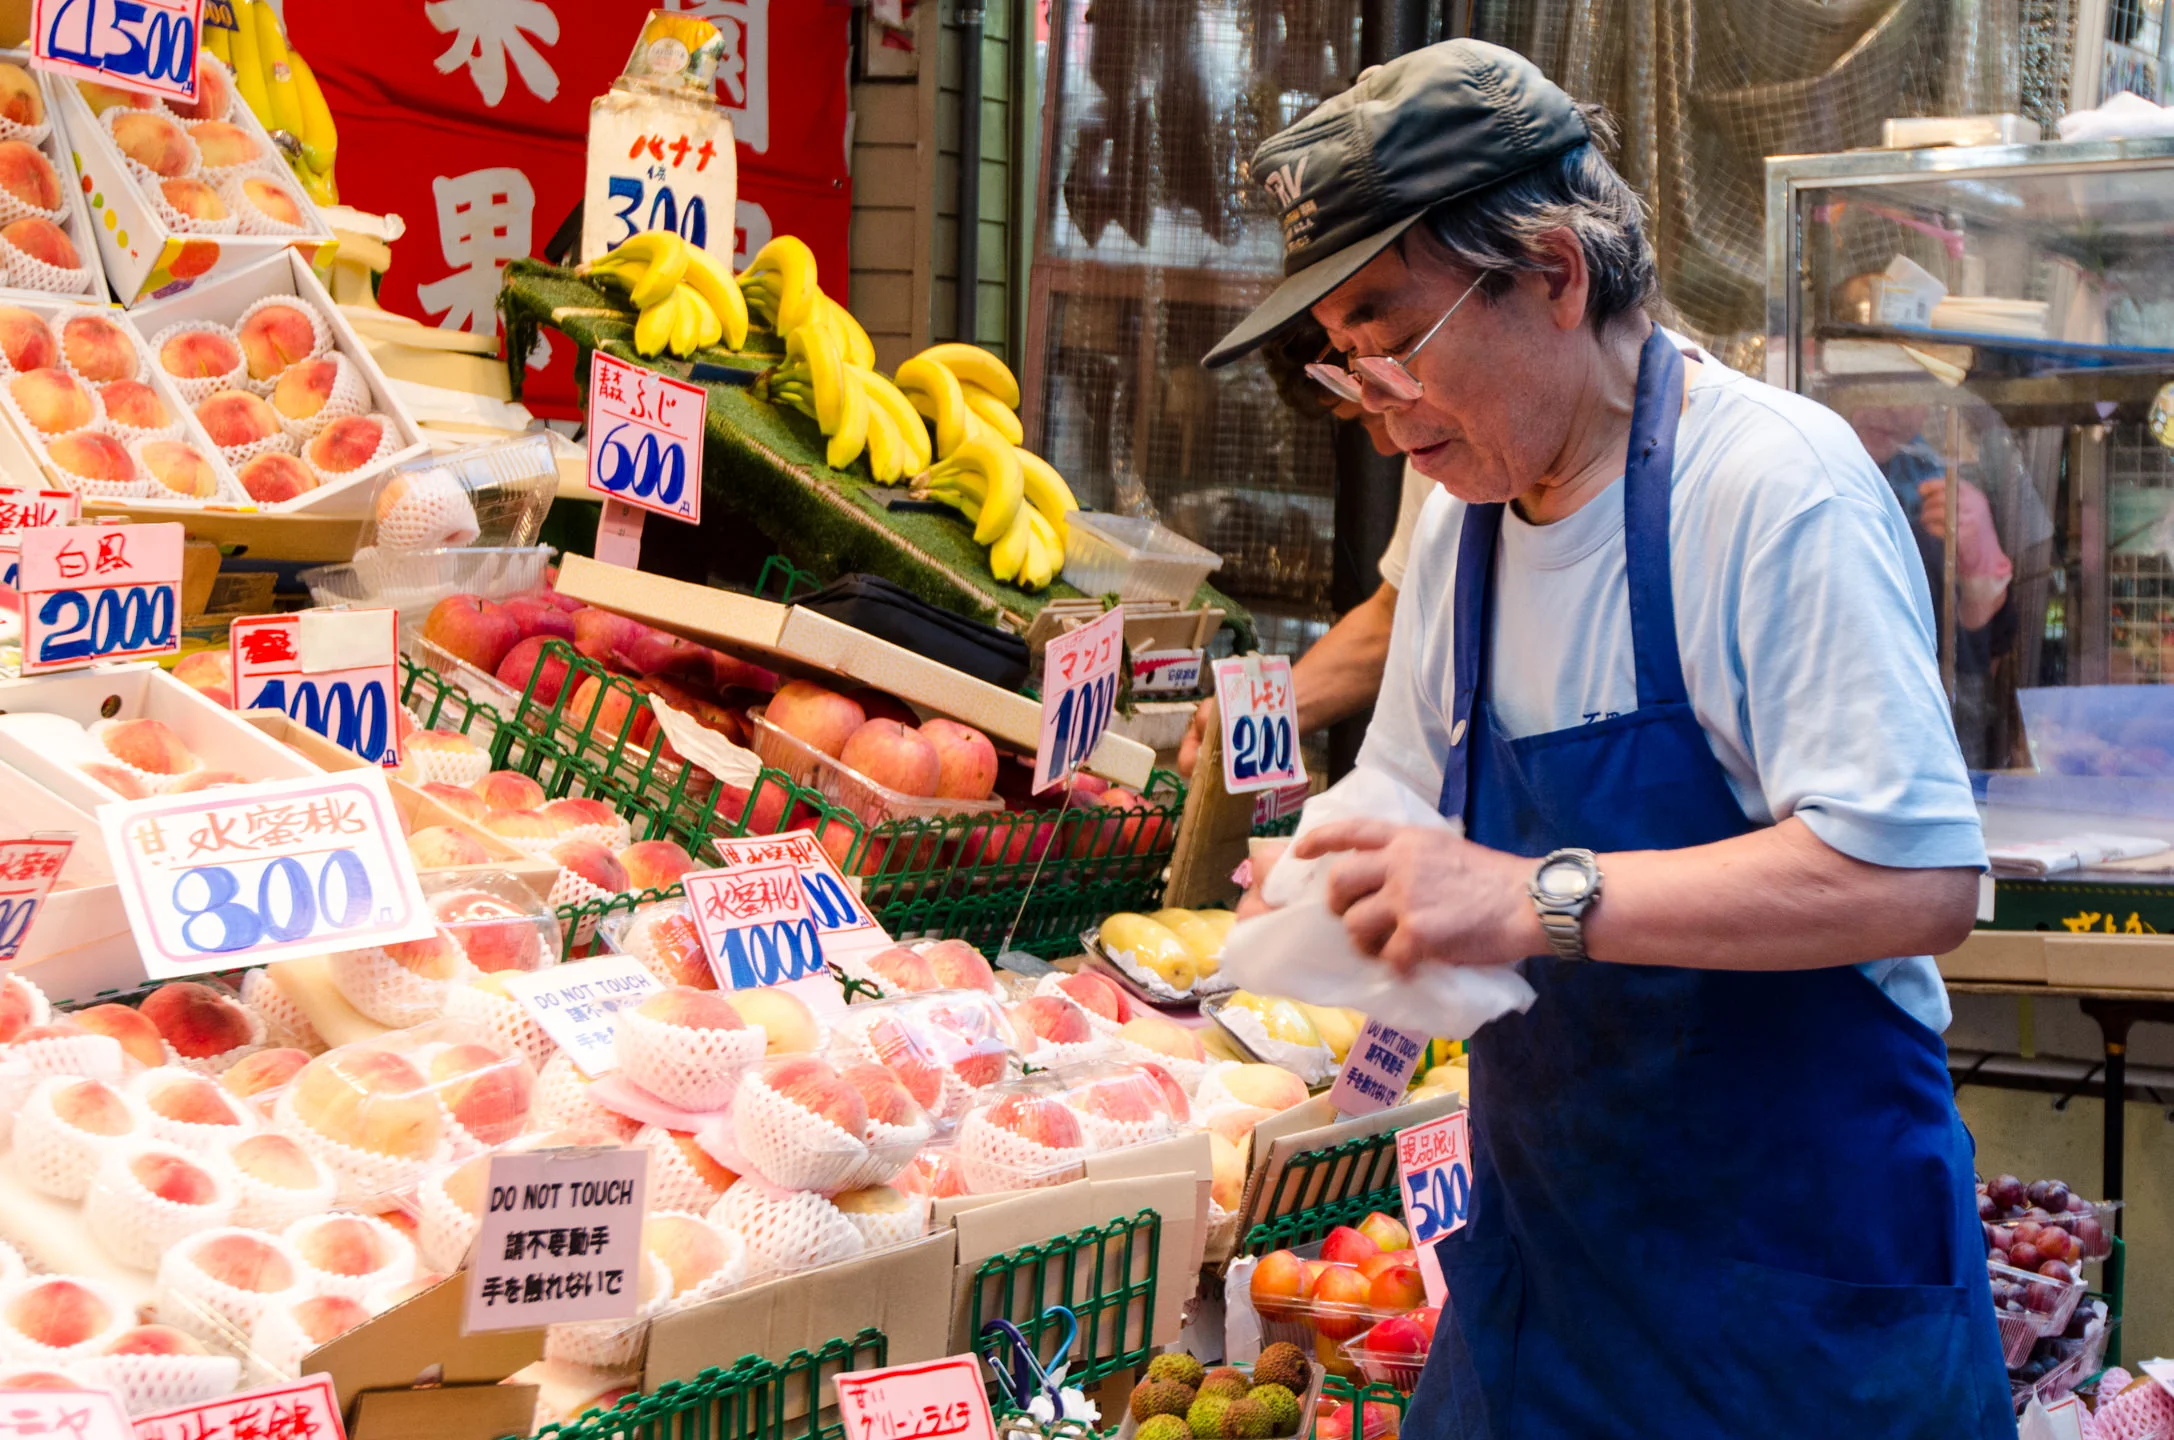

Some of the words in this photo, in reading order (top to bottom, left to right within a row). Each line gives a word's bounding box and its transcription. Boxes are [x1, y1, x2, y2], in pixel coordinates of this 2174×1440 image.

[628, 132, 717, 173] バナナ
[630, 379, 677, 427] ふじ
[1251, 679, 1287, 712] レモン
[188, 796, 368, 860] 水蜜桃
[706, 875, 799, 921] 水蜜桃
[533, 992, 560, 1009] DO
[560, 984, 594, 1003] NOT
[595, 974, 652, 994] TOUCH
[1379, 1027, 1399, 1047] NOT
[1396, 1035, 1421, 1061] TOUCH
[490, 1185, 517, 1212] DO
[523, 1183, 563, 1210] NOT
[570, 1179, 634, 1208] TOUCH
[1407, 1162, 1469, 1241] 500
[481, 1269, 624, 1307] 手を触れないで
